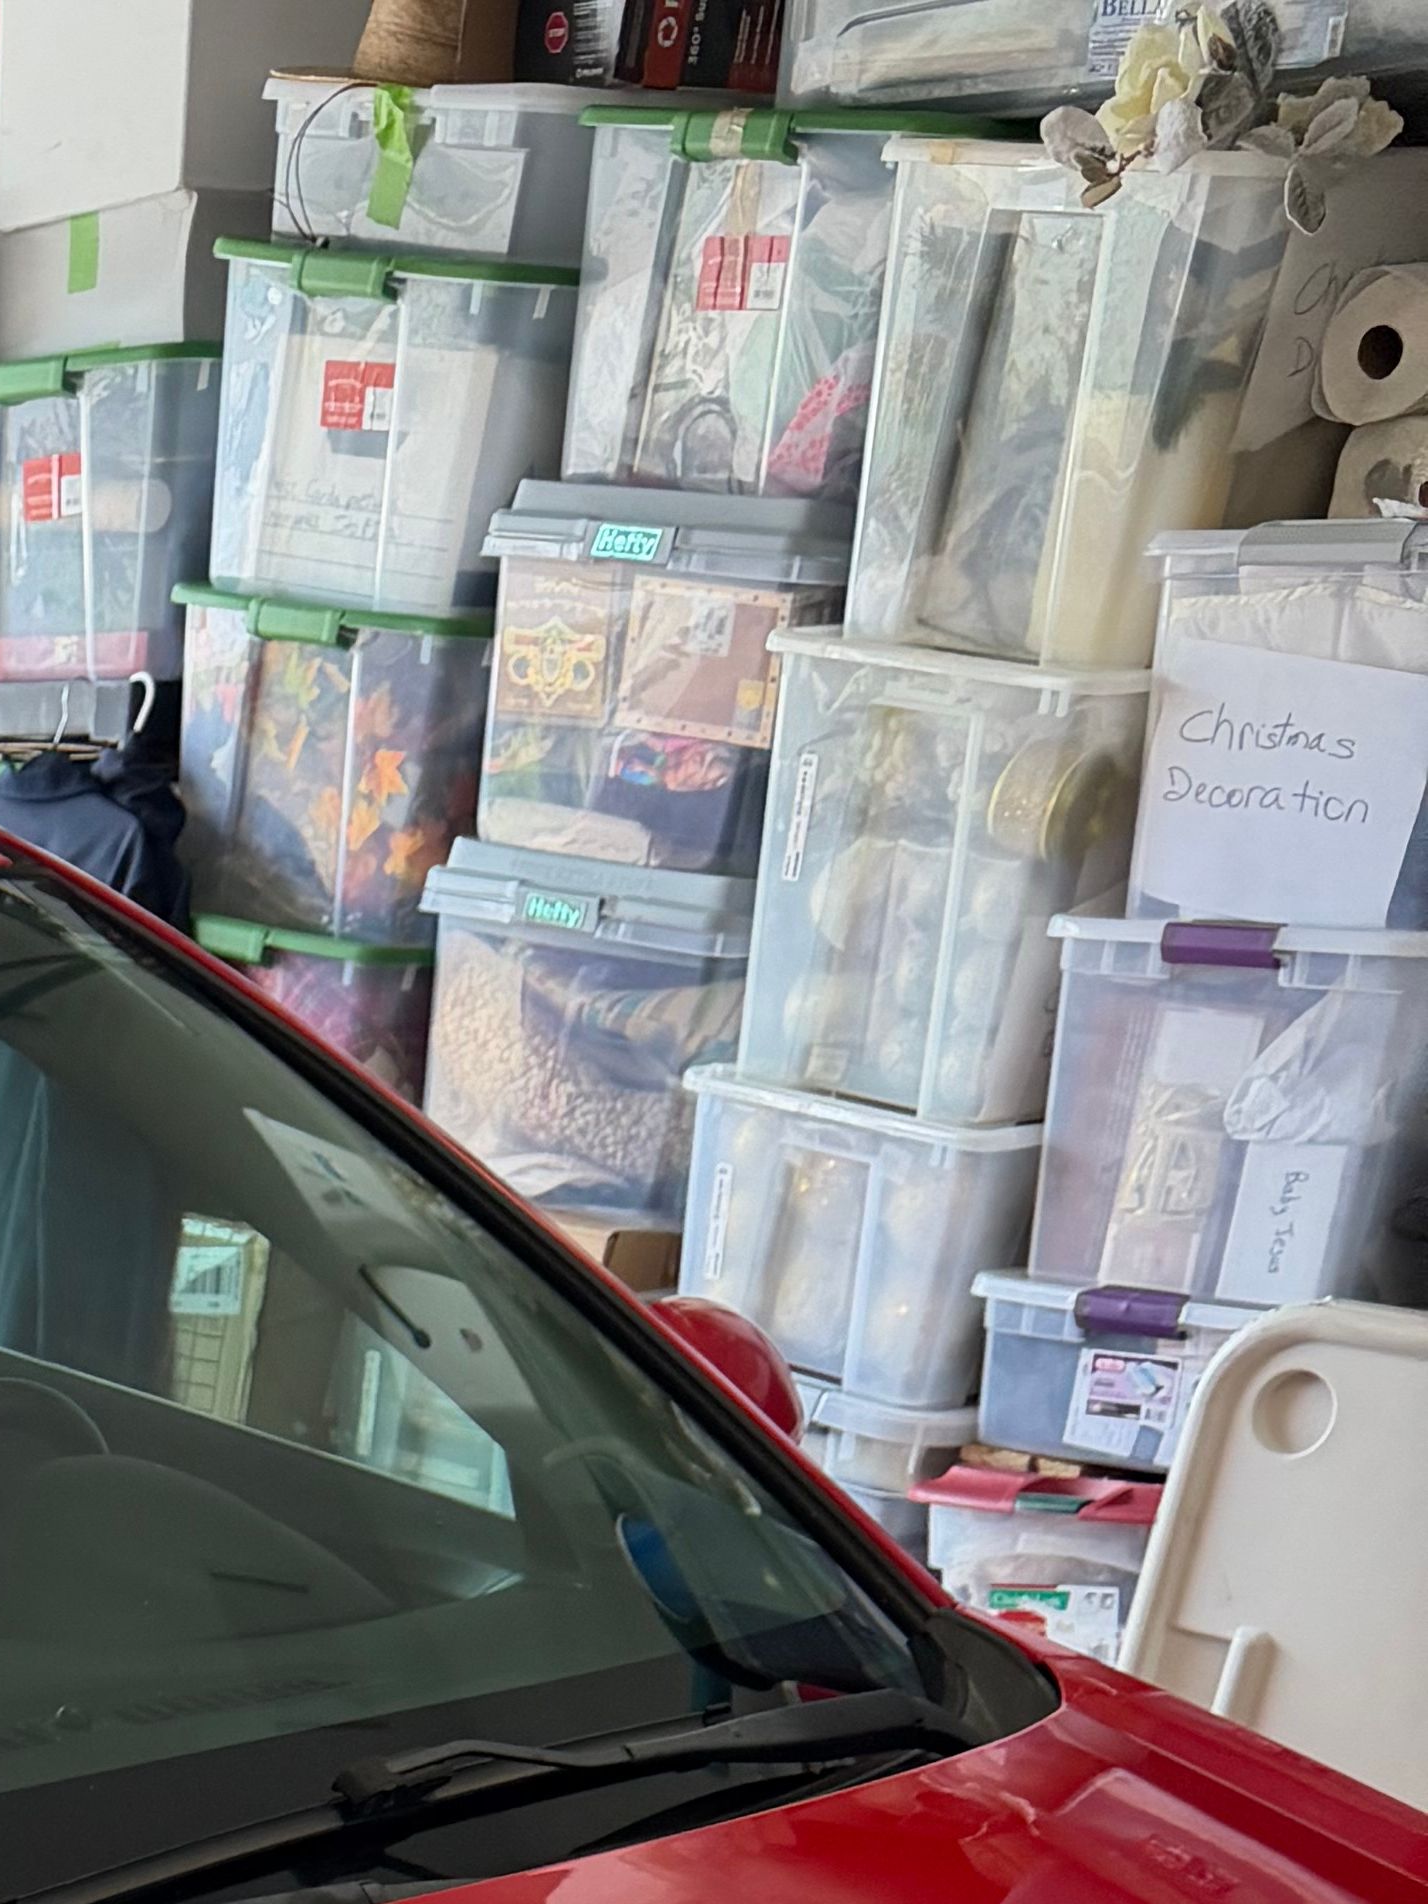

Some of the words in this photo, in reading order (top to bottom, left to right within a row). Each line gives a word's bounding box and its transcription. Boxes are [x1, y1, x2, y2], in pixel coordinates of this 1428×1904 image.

[598, 528, 656, 557] Hefty
[1179, 702, 1356, 759] Christmas
[1162, 765, 1370, 824] Decoration
[527, 896, 581, 929] Hefty
[1268, 1170, 1310, 1216] Baby
